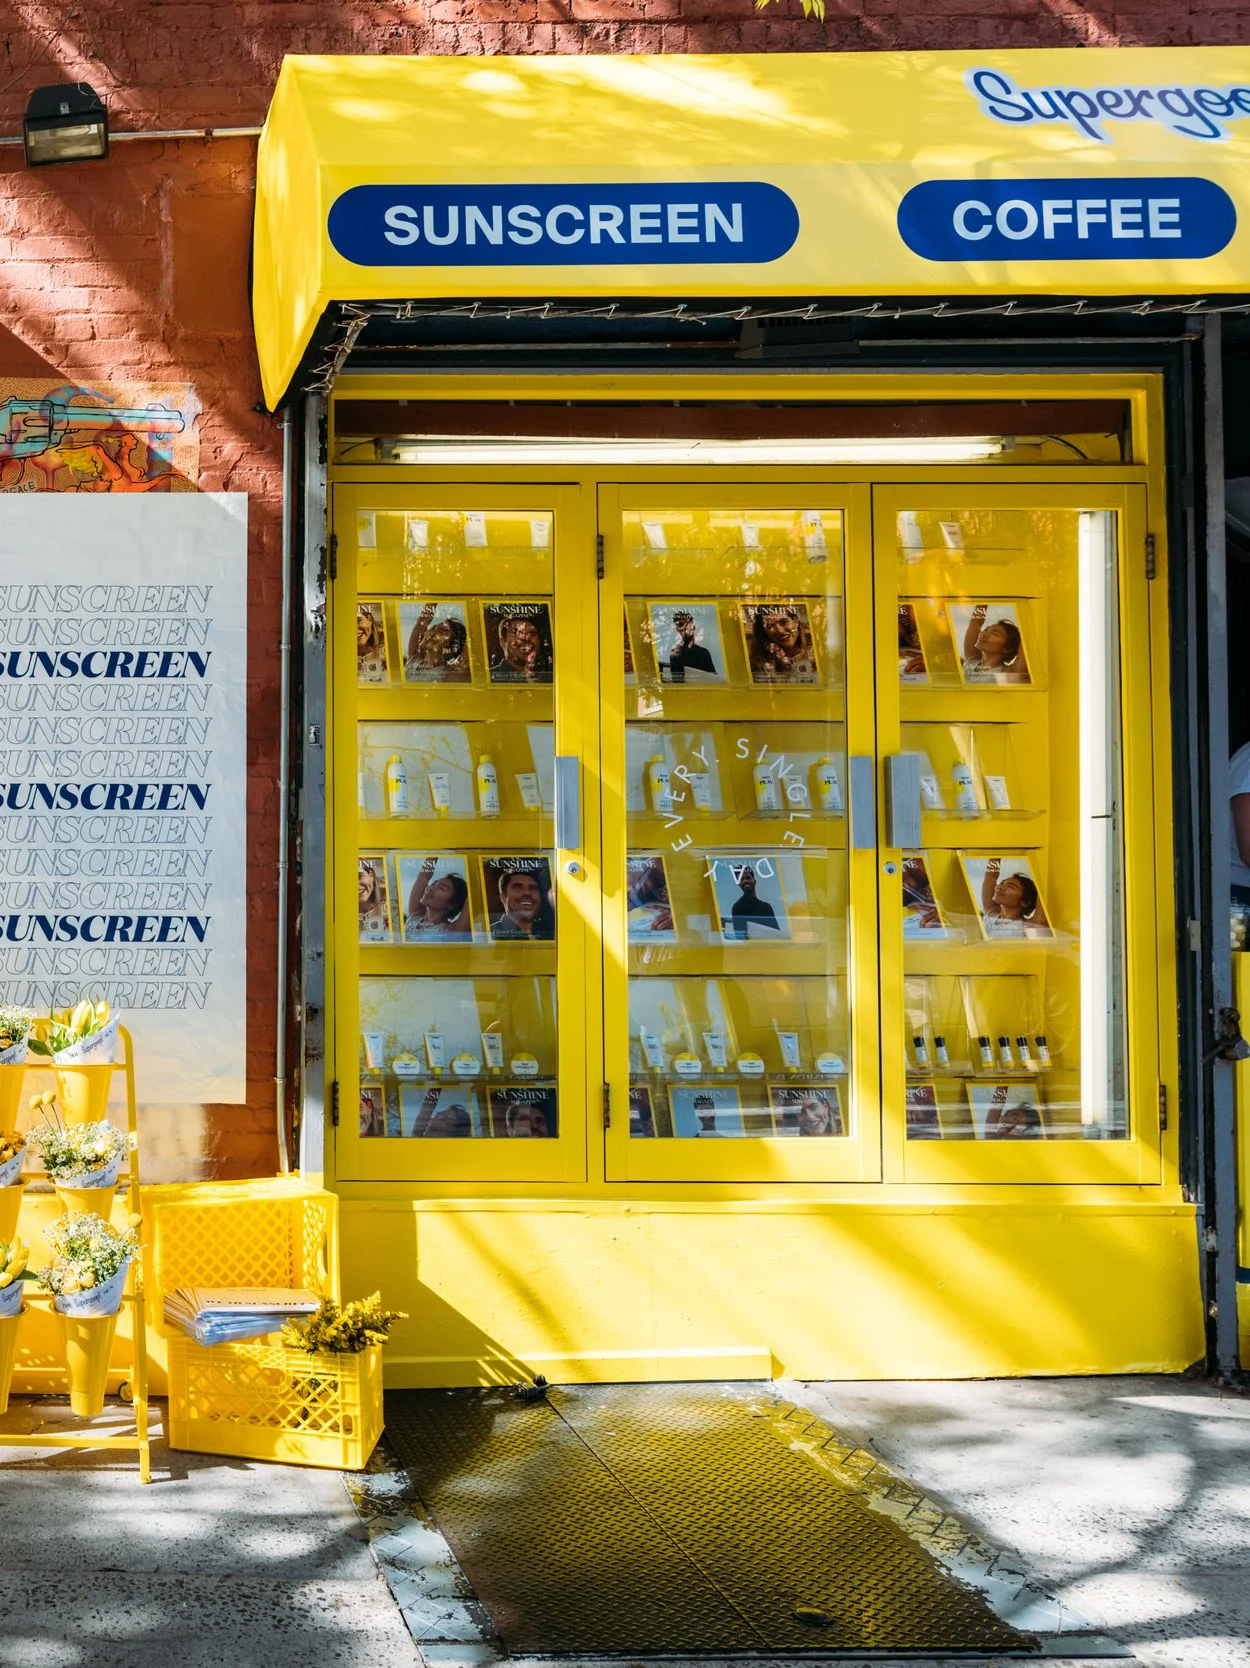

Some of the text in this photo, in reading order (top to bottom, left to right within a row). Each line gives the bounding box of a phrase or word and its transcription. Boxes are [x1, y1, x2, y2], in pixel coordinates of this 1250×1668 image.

[952, 198, 1182, 241] COFFEE
[383, 203, 744, 246] SUNSCREEN
[490, 606, 542, 614] SUNSHINE
[490, 860, 542, 868] SUNSHINE
[497, 1091, 550, 1100] SUNSHINE
[778, 1090, 830, 1098] SUNSHINE
